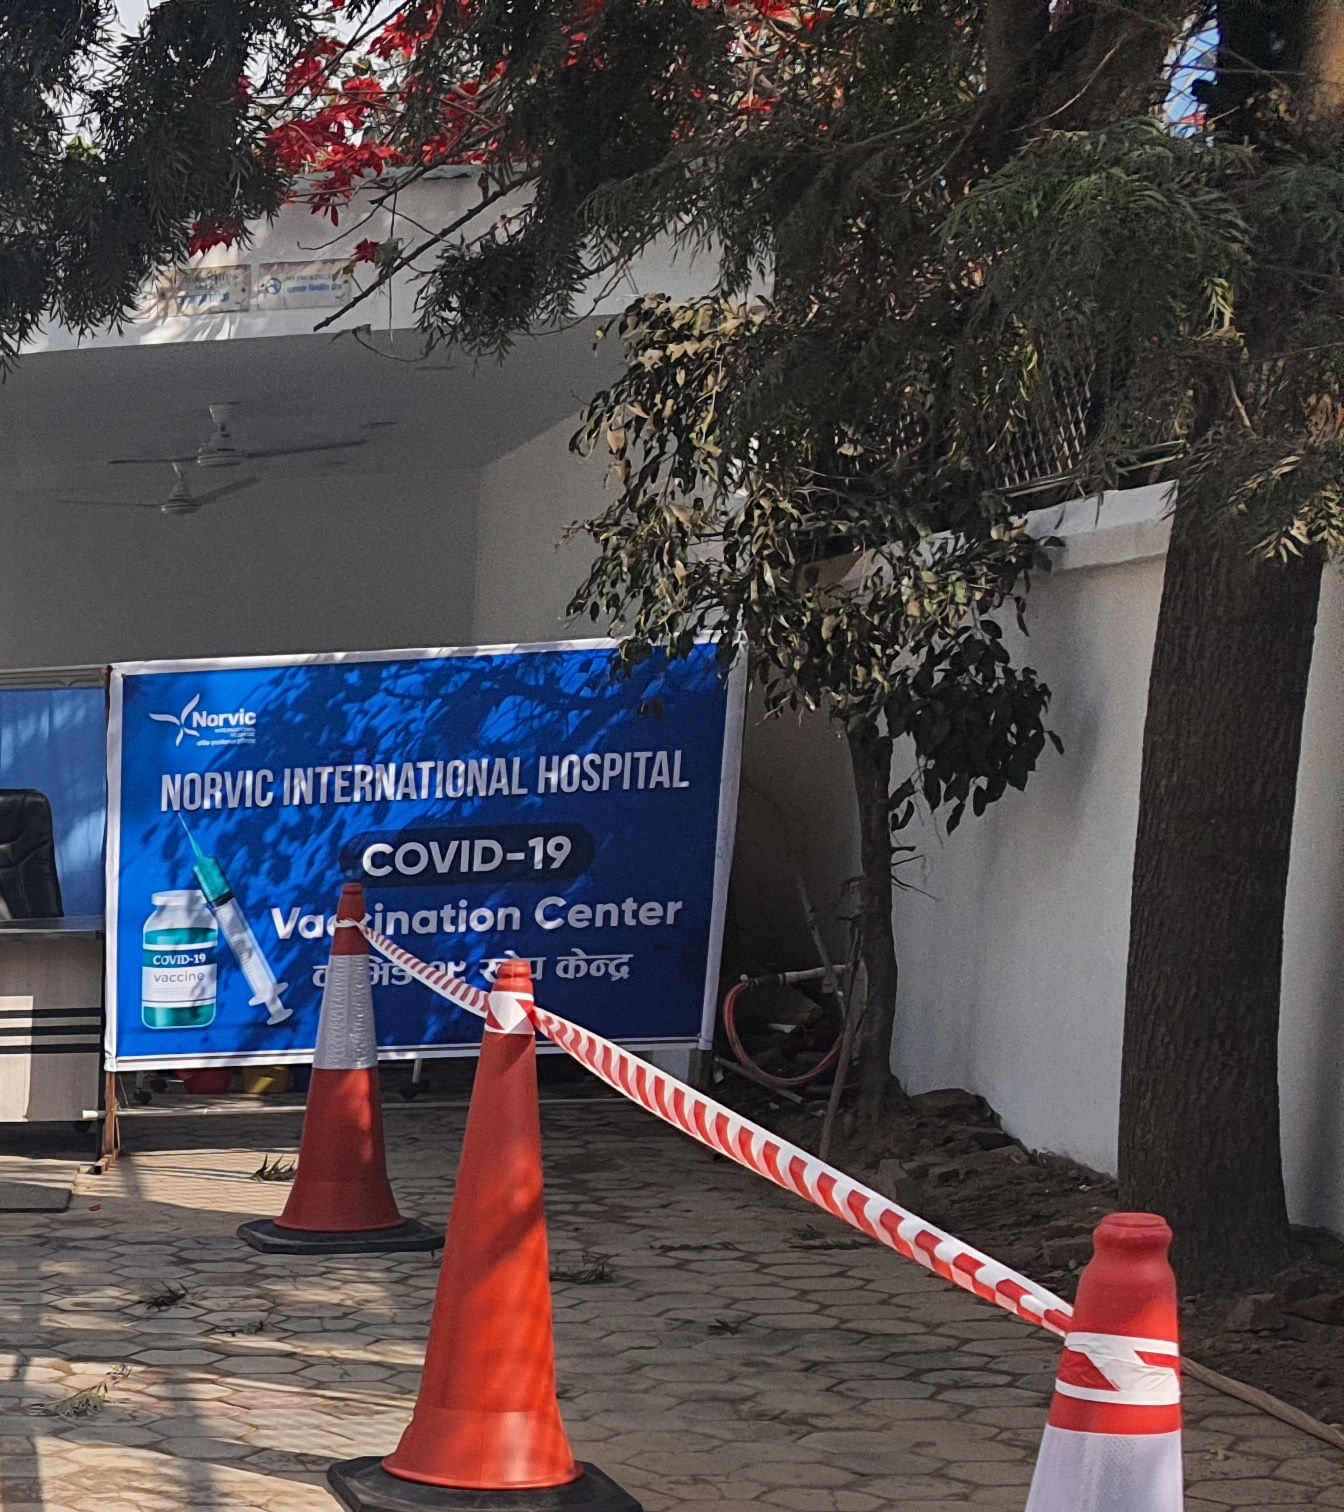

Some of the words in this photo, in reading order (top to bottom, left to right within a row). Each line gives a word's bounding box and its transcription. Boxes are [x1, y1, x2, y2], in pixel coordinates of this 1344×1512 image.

[192, 708, 256, 727] Norvic
[161, 768, 274, 812] NORVIC
[283, 757, 528, 806] INTERNATIONAL
[538, 750, 690, 793] HOSPITAL
[362, 835, 572, 877] COVID-19
[271, 899, 520, 940] Vaination
[534, 896, 682, 931] Center
[153, 953, 207, 965] COVID-19
[556, 948, 634, 981] केन्द्र
[154, 971, 205, 983] vaccine
